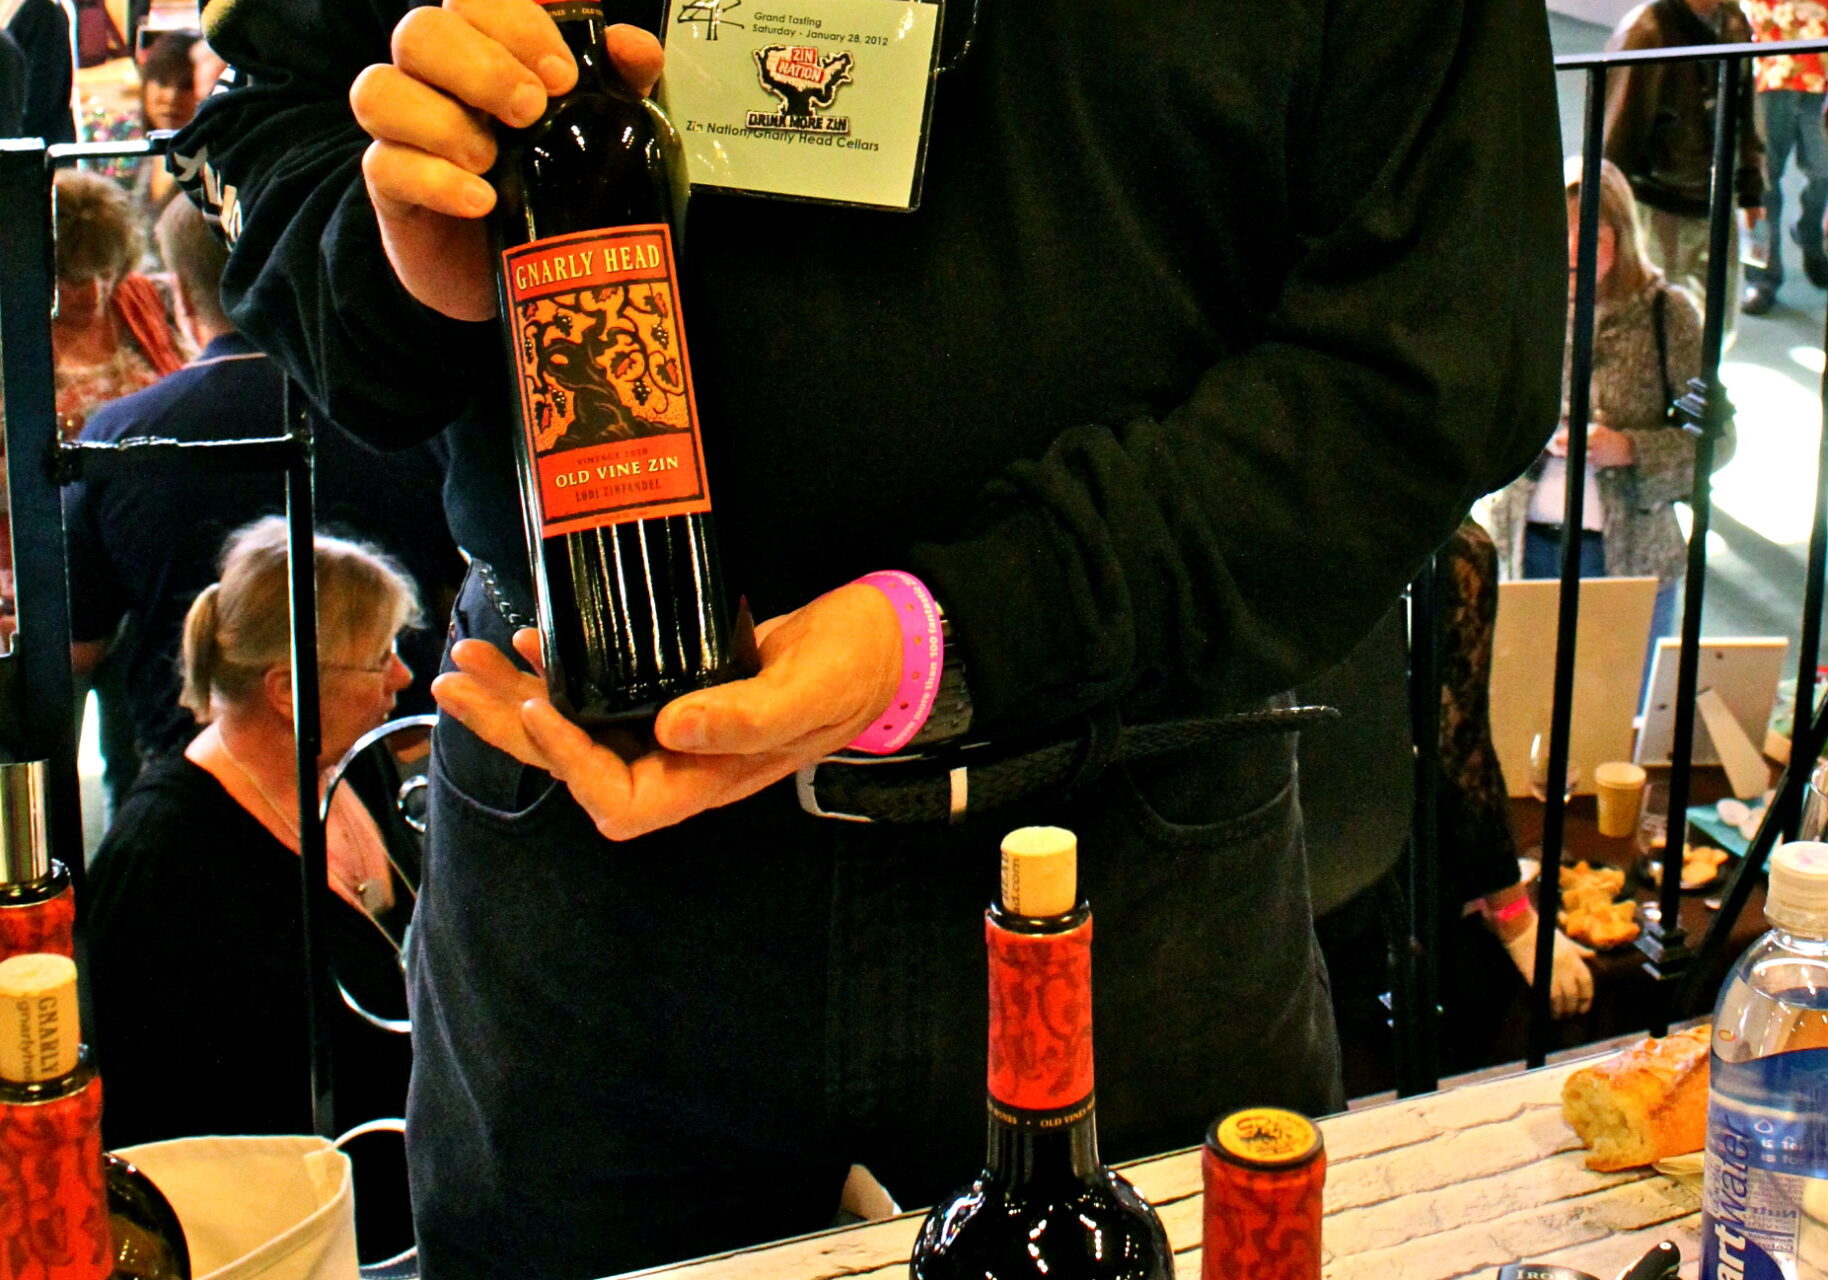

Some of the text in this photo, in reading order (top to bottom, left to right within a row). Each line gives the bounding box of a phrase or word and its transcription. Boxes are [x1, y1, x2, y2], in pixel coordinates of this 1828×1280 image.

[753, 11, 822, 28] Grand Tasting
[752, 23, 797, 38] Saturday
[806, 29, 846, 43] January
[864, 35, 889, 46] 2012
[791, 48, 814, 63] ZIN
[778, 61, 822, 81] NATION
[748, 112, 847, 131] DRINK MORE ZIN
[798, 131, 832, 147] Head
[837, 136, 880, 152] Cellars
[515, 244, 660, 290] GNARLY HEAD
[555, 456, 679, 488] OLD VINE ZIN
[929, 635, 938, 658] 100
[924, 661, 938, 690] than
[38, 996, 60, 1073] GNARLY
[1040, 1117, 1062, 1128] OLD
